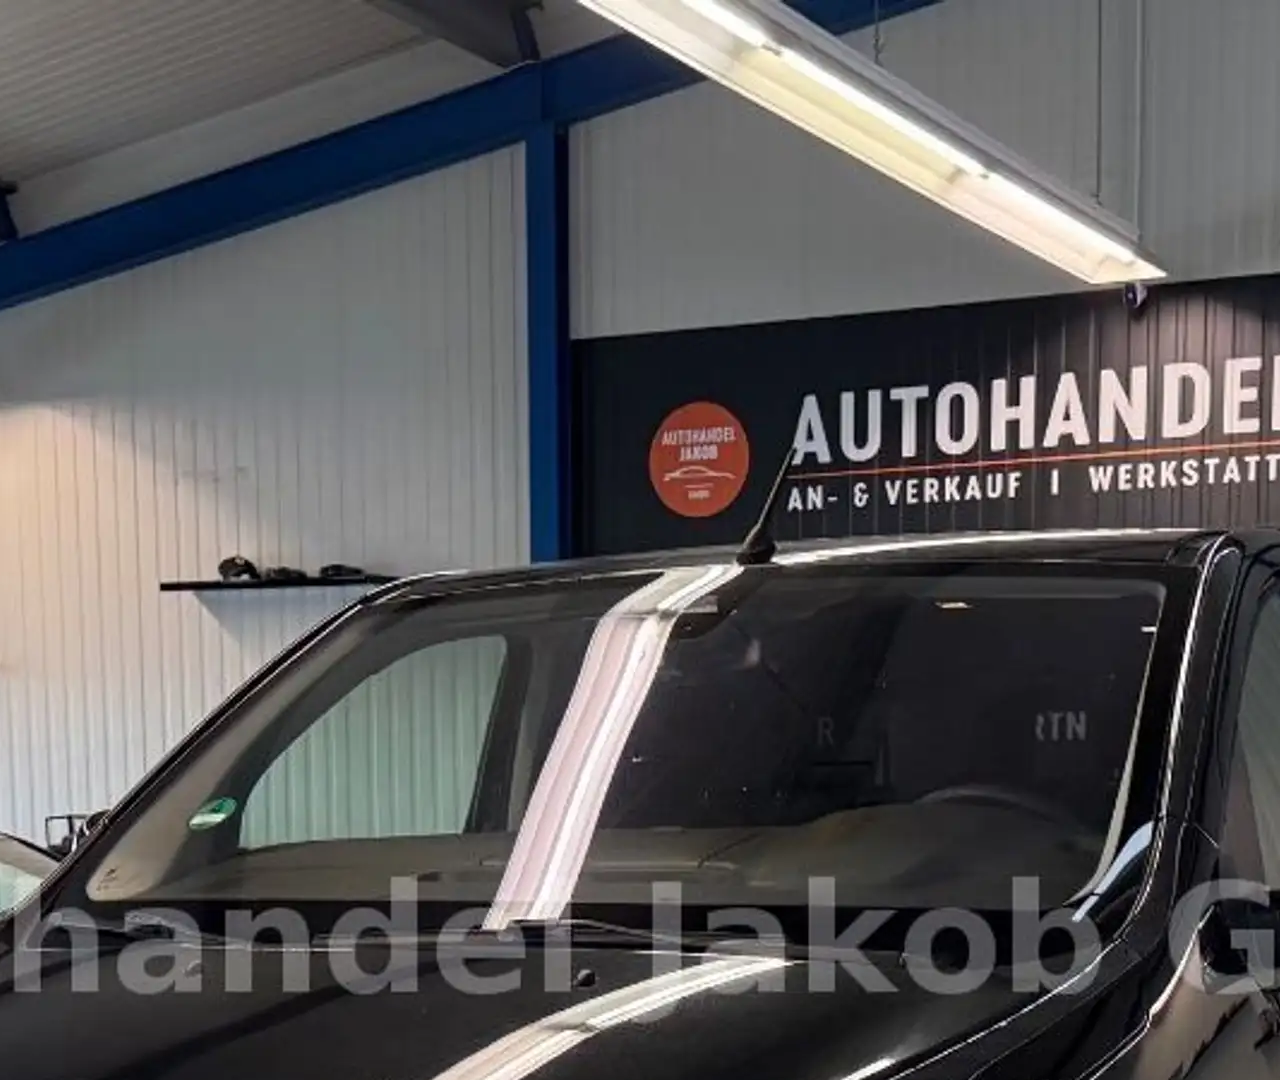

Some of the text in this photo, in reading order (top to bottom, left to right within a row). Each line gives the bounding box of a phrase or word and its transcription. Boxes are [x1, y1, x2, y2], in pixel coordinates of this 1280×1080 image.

[787, 484, 839, 513] AN-
[853, 482, 869, 508] &
[884, 471, 1022, 506] VERKAUF
